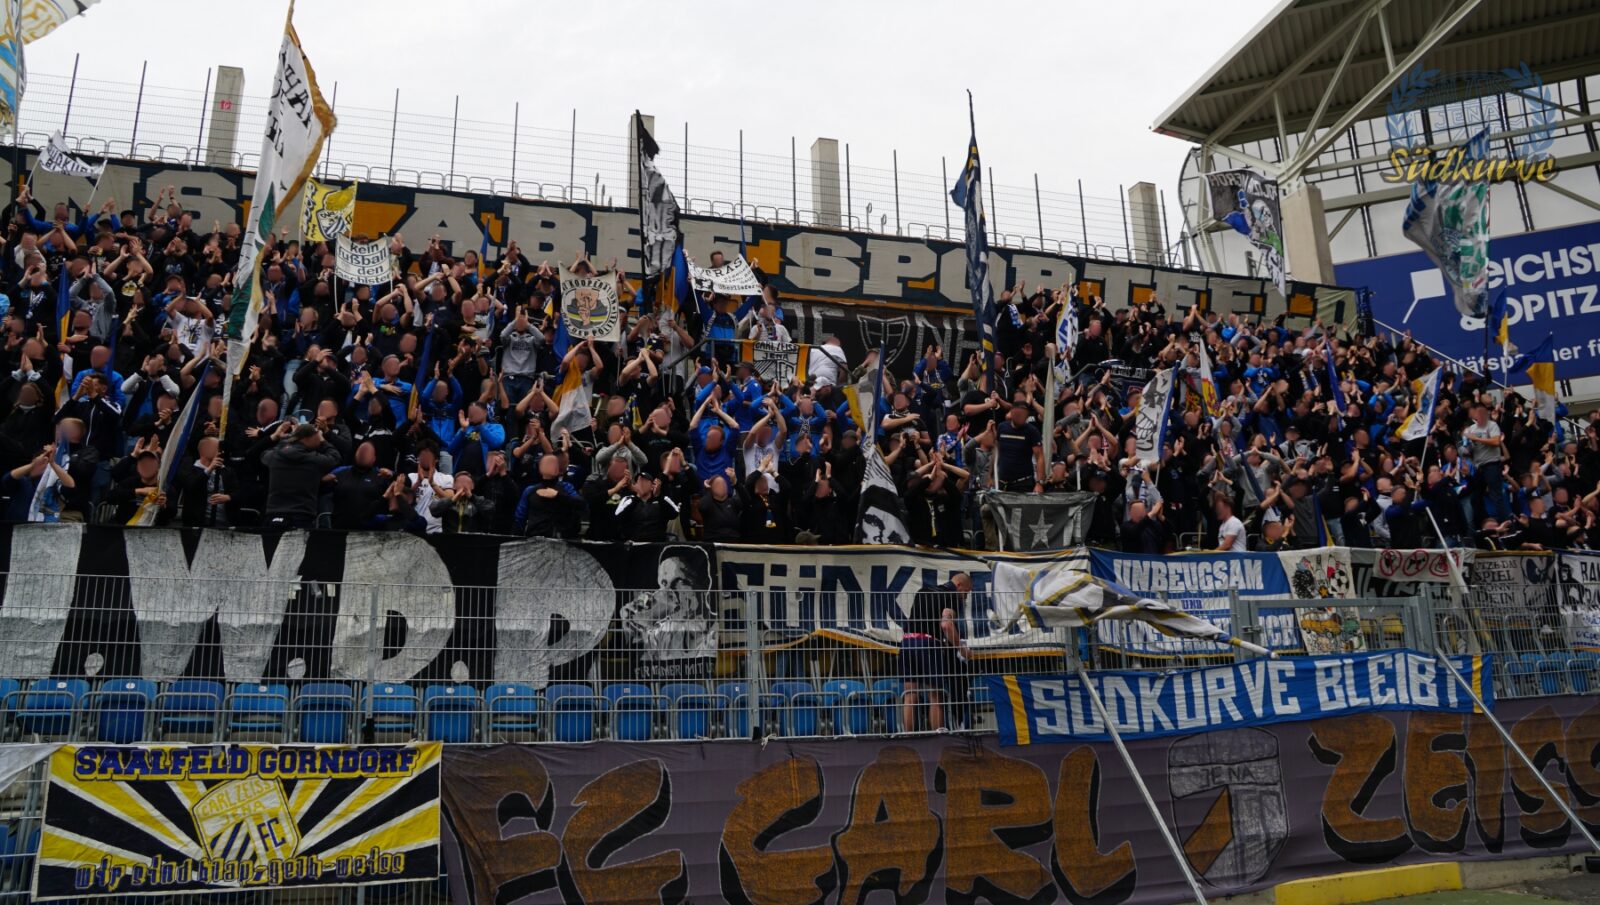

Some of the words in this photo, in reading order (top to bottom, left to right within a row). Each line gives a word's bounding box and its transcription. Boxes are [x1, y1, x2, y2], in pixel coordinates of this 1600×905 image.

[338, 246, 387, 265] fußball
[350, 242, 379, 254] kein
[357, 265, 384, 276] den
[1487, 243, 1600, 289] eICHST
[763, 352, 789, 360] JENA
[1113, 558, 1265, 594] UNBEUGSAM
[1474, 570, 1514, 582] SPIEL
[1032, 657, 1301, 736] SÜDKURVE
[1314, 651, 1465, 713] BLEIBT
[74, 745, 250, 778] SAALFELD
[257, 746, 419, 776] GORNDORF
[1199, 766, 1256, 790] JENA
[201, 790, 235, 817] CARL
[236, 779, 271, 803] ZEISS
[224, 800, 265, 825] JENA
[256, 816, 288, 852] FC
[720, 745, 1138, 905] CARL
